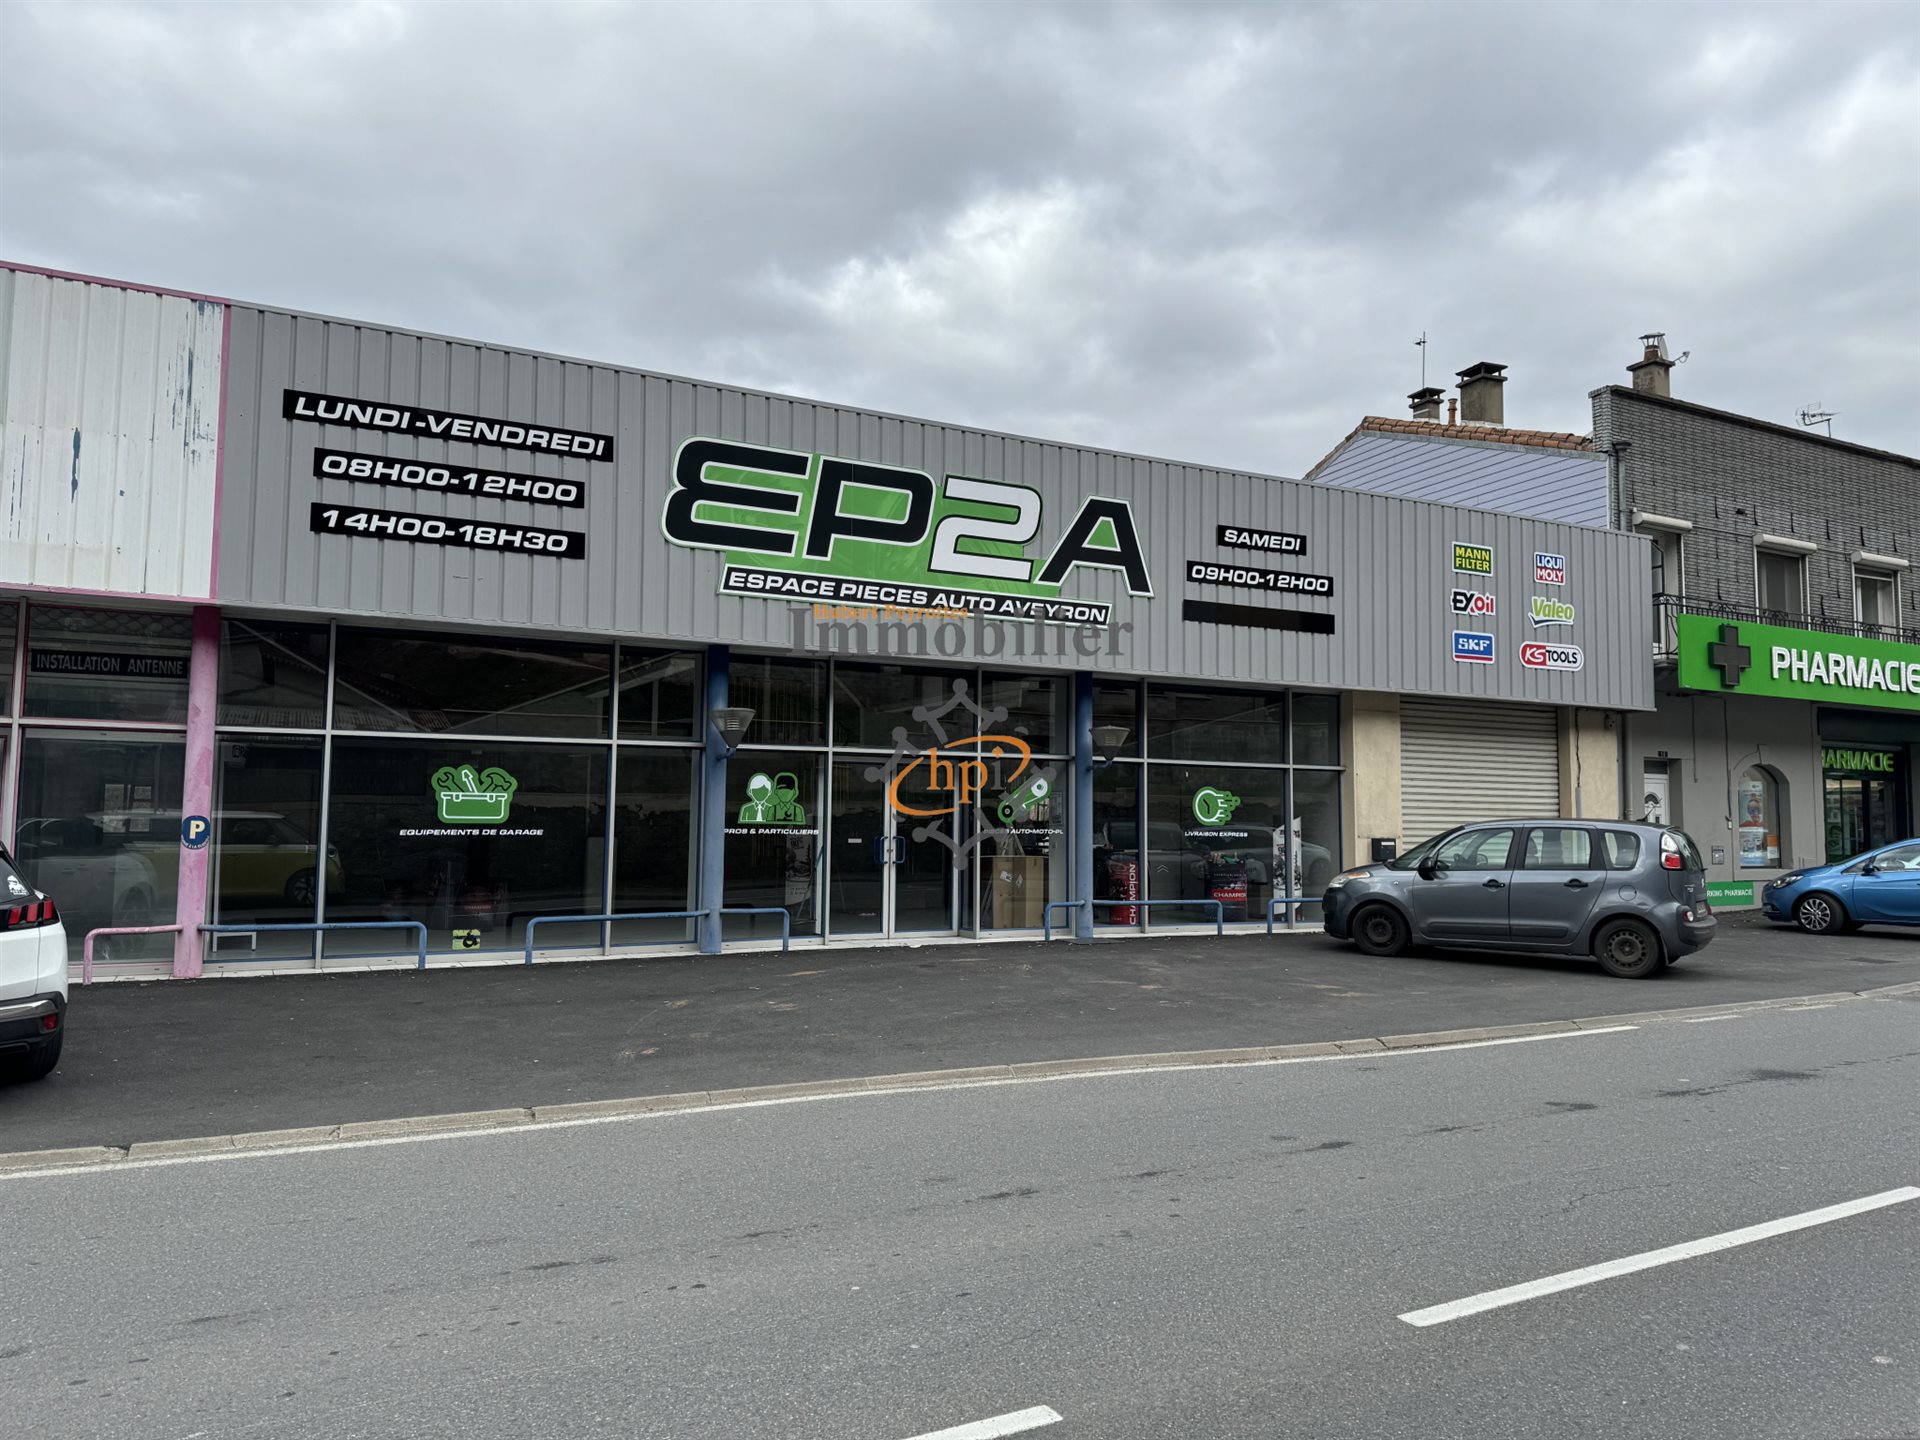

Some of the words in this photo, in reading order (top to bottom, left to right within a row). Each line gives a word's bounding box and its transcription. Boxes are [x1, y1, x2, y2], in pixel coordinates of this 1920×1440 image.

[294, 396, 606, 456] LUNDI-VENDREDI
[321, 455, 578, 502] 08H00-12H00
[661, 436, 1155, 598] EP2A
[321, 509, 569, 552] 14H00-18H30
[1224, 529, 1301, 551] SAMEDI
[1455, 546, 1490, 561] MANN
[1455, 558, 1490, 571] FILTER
[1536, 555, 1563, 569] LIQUI
[1191, 565, 1329, 592] 09H00-12H00
[1536, 568, 1564, 582] MOLY
[727, 571, 836, 597] ESPACE
[839, 582, 928, 605] PIECES
[931, 592, 997, 613] AUTO
[998, 599, 1108, 623] AVEYRON
[1532, 597, 1574, 620] Valeo
[1458, 638, 1490, 651] SKF
[36, 653, 121, 672] INSTALLATION
[127, 658, 183, 675] ANTENNE
[1546, 649, 1578, 665] TOOLS
[1771, 646, 1920, 694] PHARMACIE
[189, 820, 206, 840] P
[1129, 863, 1137, 925] CHMPION
